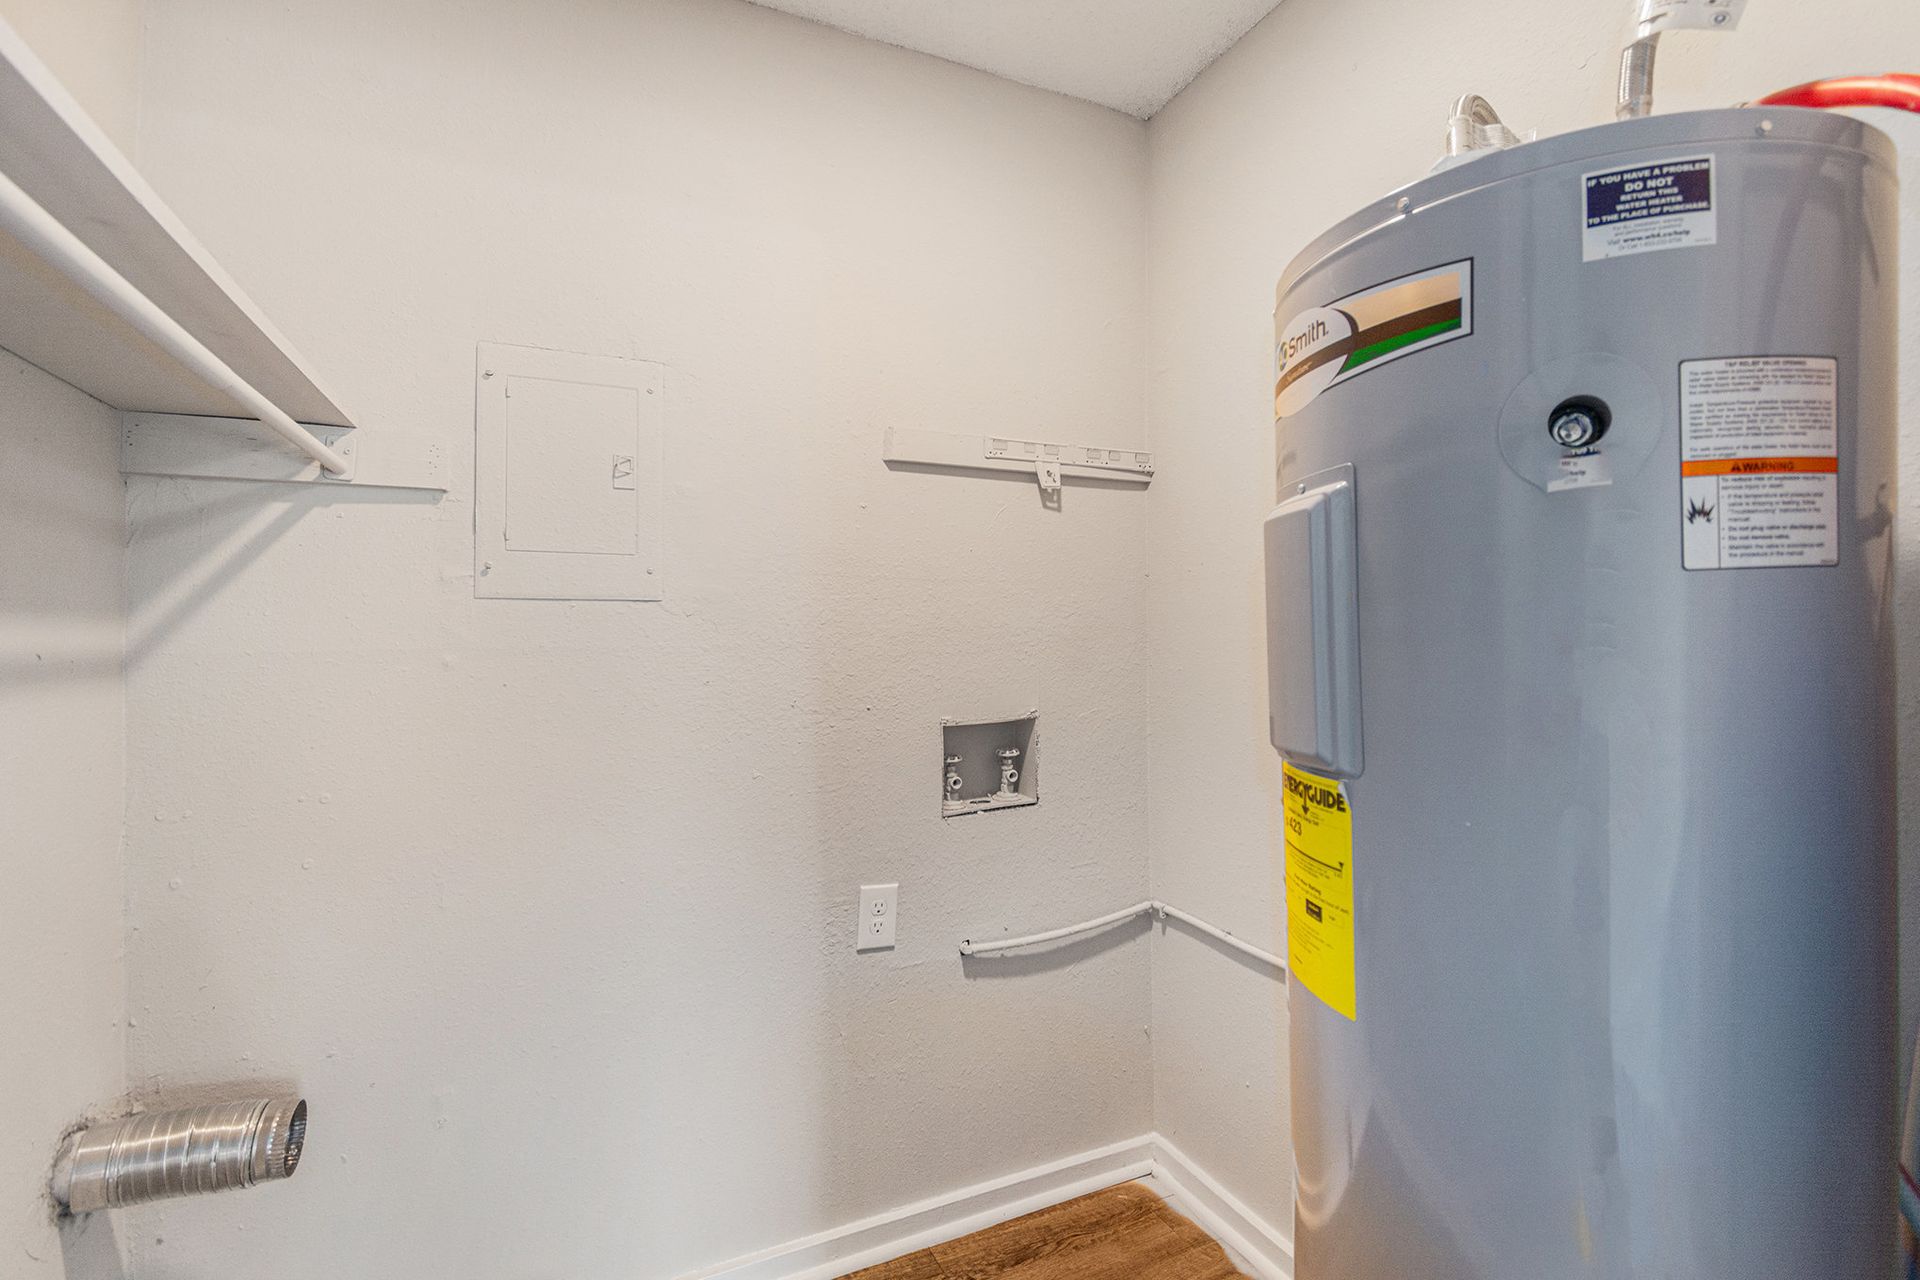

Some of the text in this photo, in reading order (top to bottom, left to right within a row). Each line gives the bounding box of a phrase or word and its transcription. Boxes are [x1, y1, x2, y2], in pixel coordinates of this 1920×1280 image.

[1588, 162, 1709, 188] IF YOU HAVE A PROBLEM
[1624, 176, 1674, 192] DO NOT
[1620, 187, 1678, 202] RETURN THIS
[1615, 195, 1683, 211] WATER HEATER
[1588, 218, 1600, 226] TO
[1602, 214, 1619, 223] THE
[1620, 210, 1648, 222] PLACE
[1650, 206, 1661, 215] OF
[1744, 462, 1795, 471] WARNING
